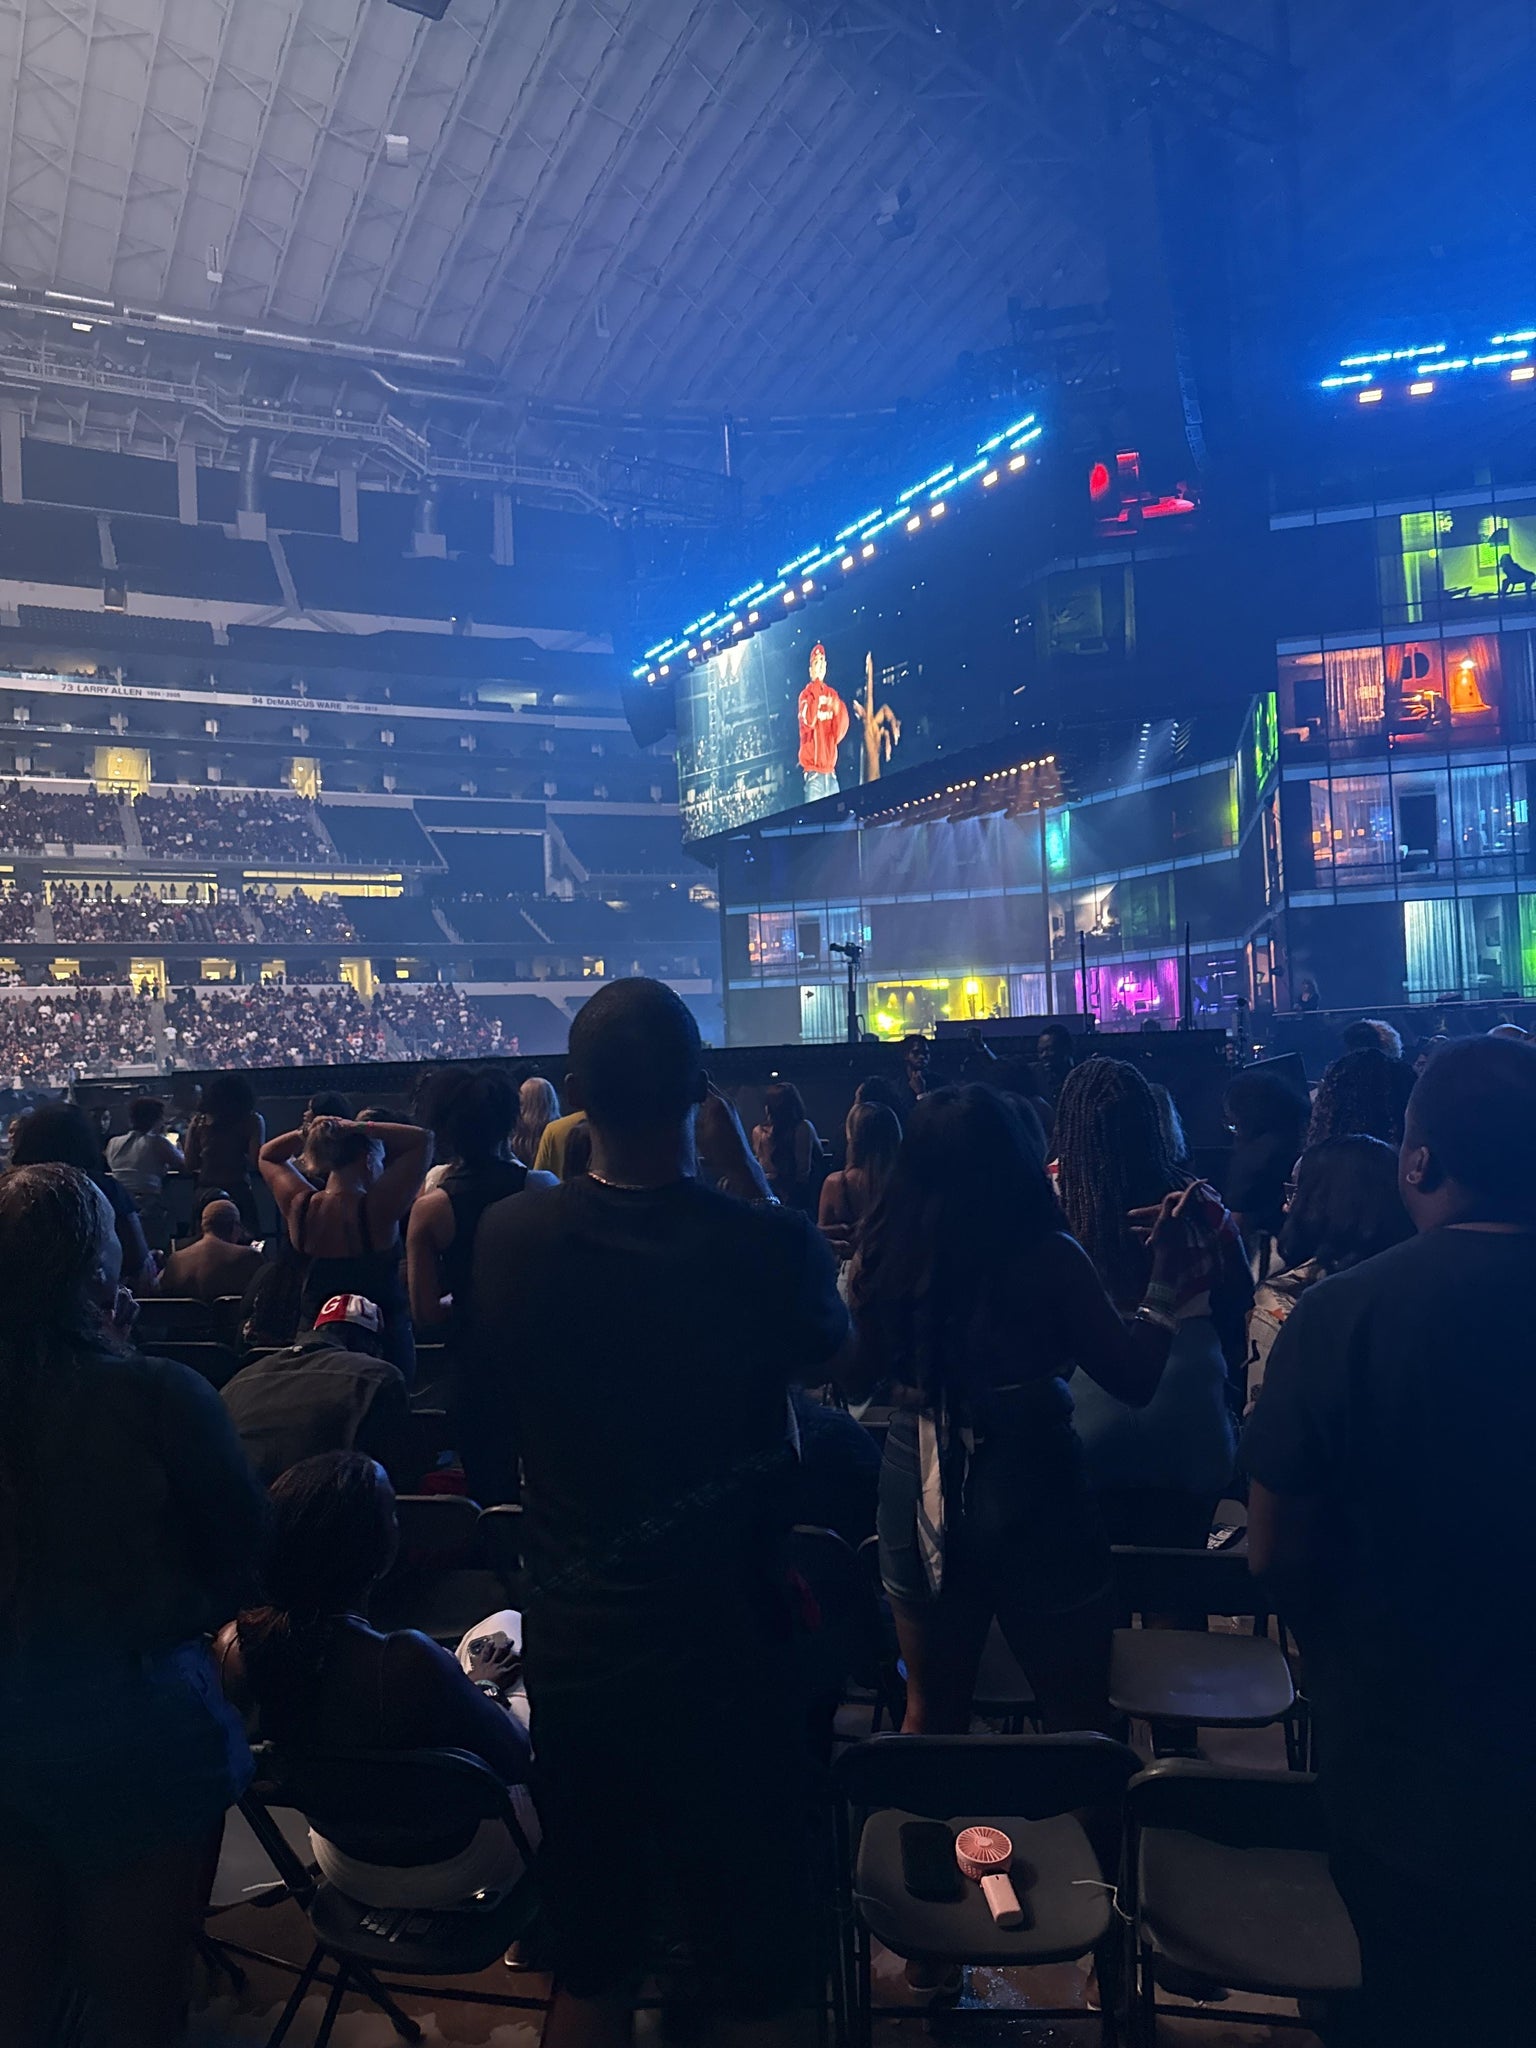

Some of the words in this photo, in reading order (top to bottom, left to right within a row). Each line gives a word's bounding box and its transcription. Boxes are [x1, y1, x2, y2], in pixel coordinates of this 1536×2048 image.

[61, 683, 74, 692] 73
[77, 684, 109, 694] LARRY
[111, 687, 142, 696] ALLEN
[317, 702, 342, 710] WARE
